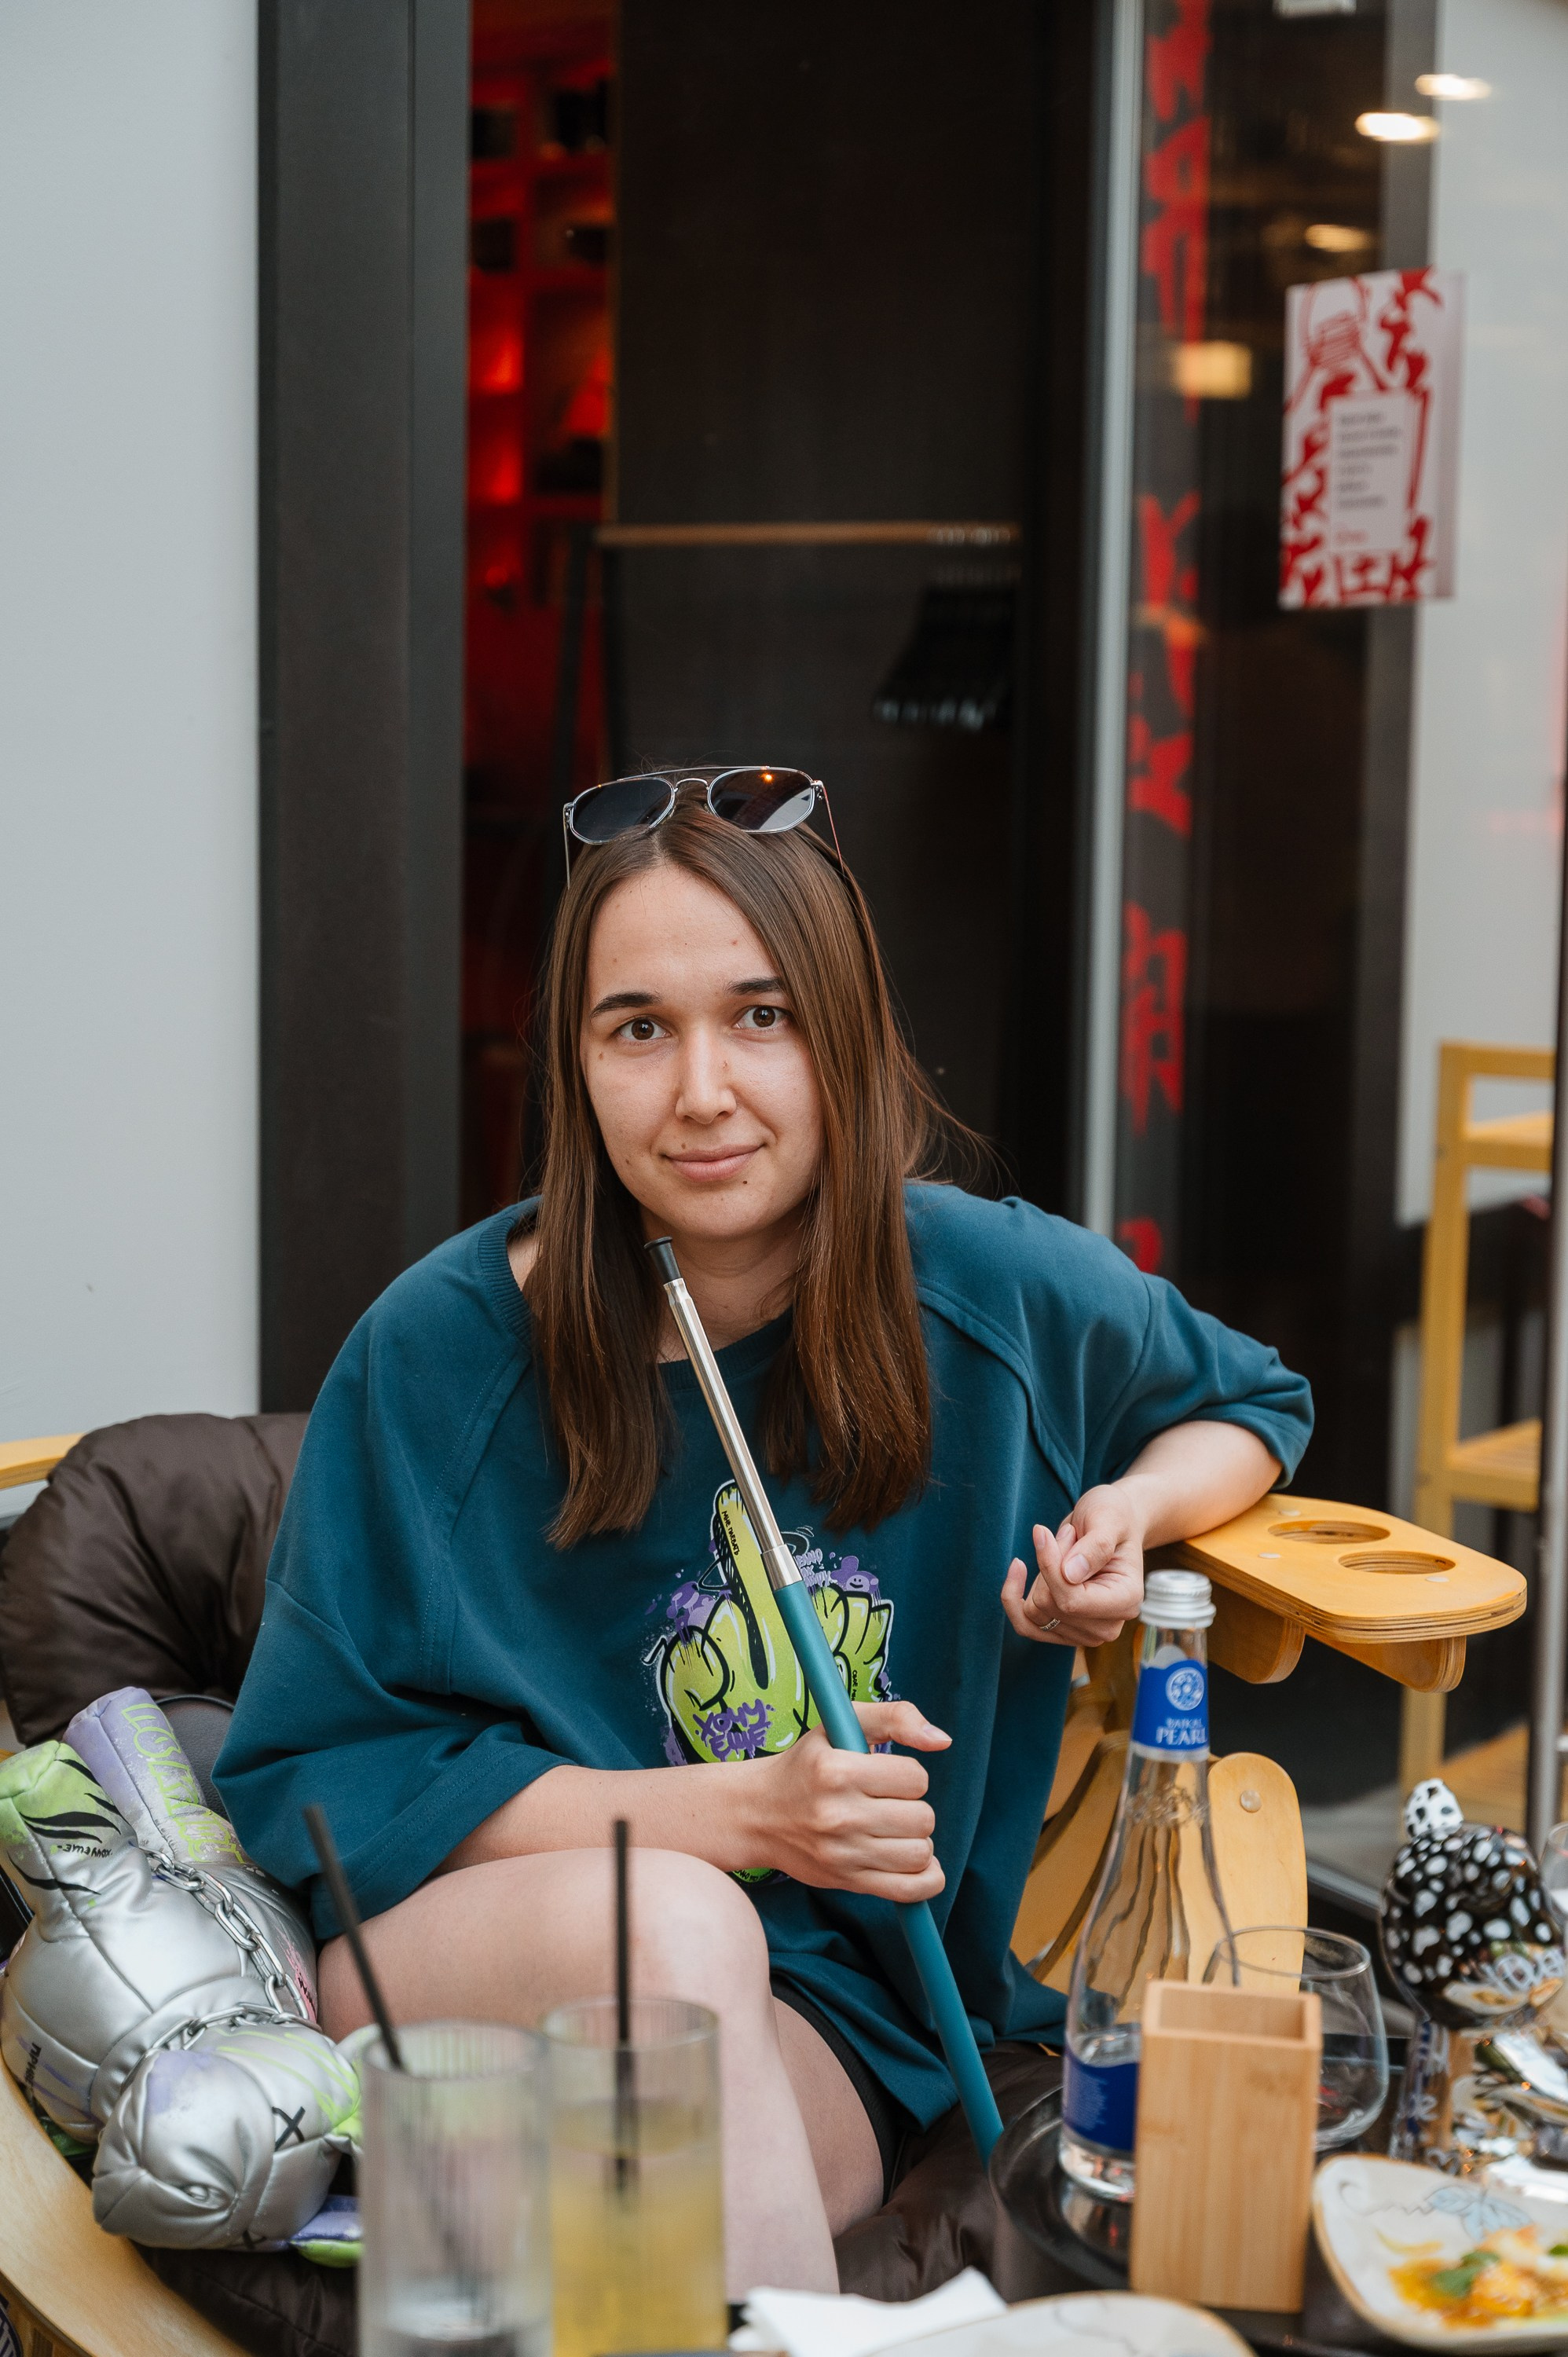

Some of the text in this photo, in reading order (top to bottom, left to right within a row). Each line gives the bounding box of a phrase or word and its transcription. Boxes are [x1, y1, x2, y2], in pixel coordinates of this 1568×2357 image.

[727, 1527, 741, 1556] ПЛЕВАТЬ
[692, 1698, 771, 1746] ХОЧУ
[1156, 1725, 1207, 1746] PEARL
